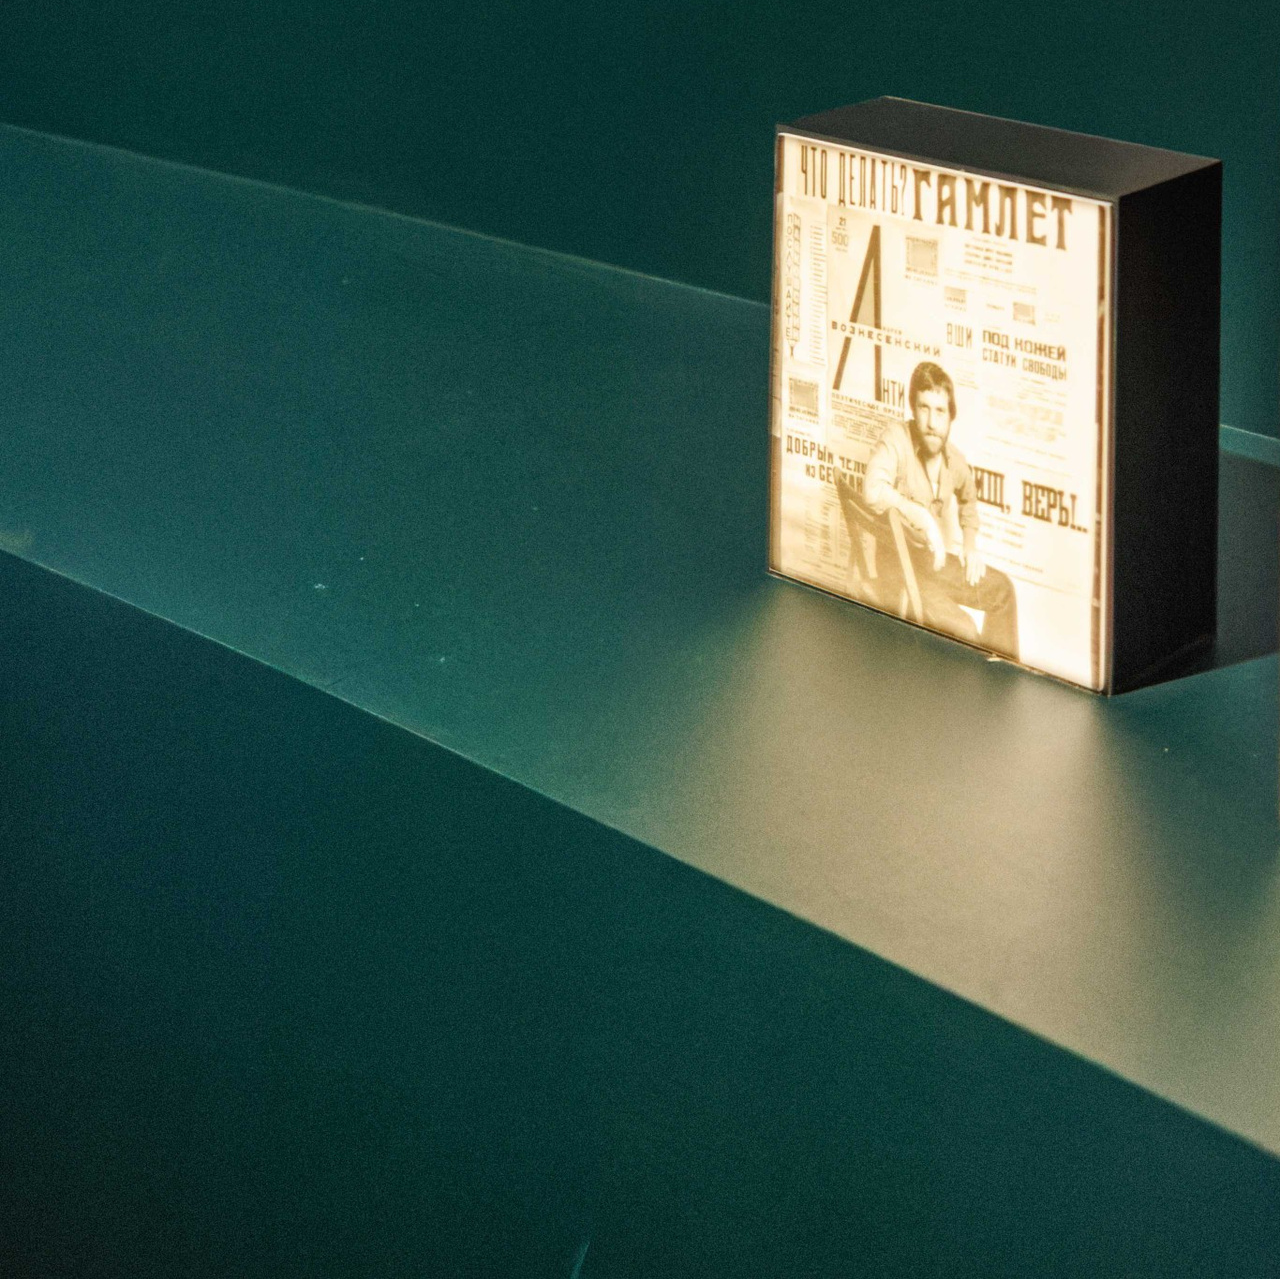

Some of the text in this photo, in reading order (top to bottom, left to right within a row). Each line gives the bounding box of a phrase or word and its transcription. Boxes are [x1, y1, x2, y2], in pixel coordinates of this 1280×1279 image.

[801, 145, 907, 216] ЧТО ДЕЛАТЬ?
[913, 168, 1073, 251] ГАМЛЕТ
[982, 347, 1067, 381] СТАТУИ СВОБОДЫ
[983, 329, 1067, 362] ПОД КОЖЕЙ
